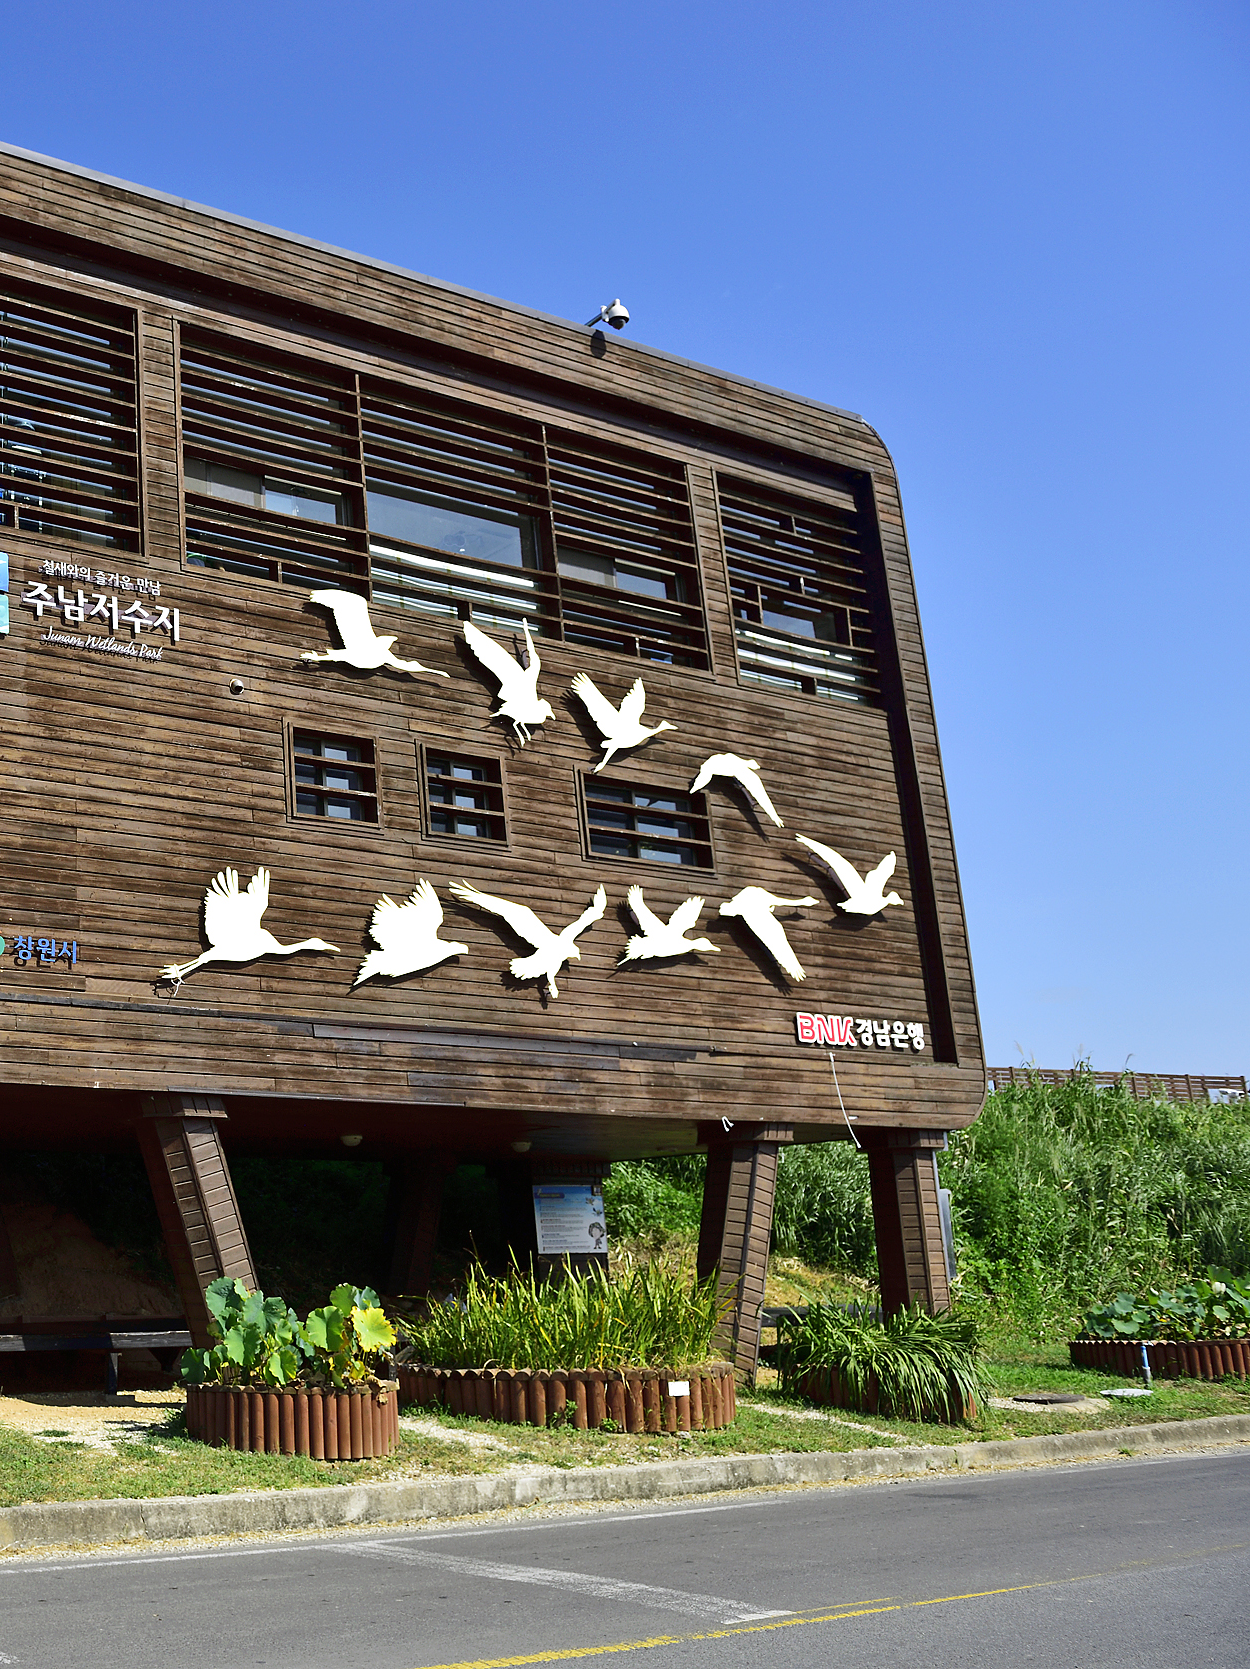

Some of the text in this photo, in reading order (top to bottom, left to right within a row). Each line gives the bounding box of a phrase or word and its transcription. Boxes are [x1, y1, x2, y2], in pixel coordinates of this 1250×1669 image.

[43, 560, 161, 596] 철새와의 즐거운 만남
[23, 580, 180, 641] 주남저수지
[43, 626, 163, 660] Junam Wetlands Park
[14, 935, 77, 964] 창원시
[797, 1012, 925, 1050] BNK 경남은행
